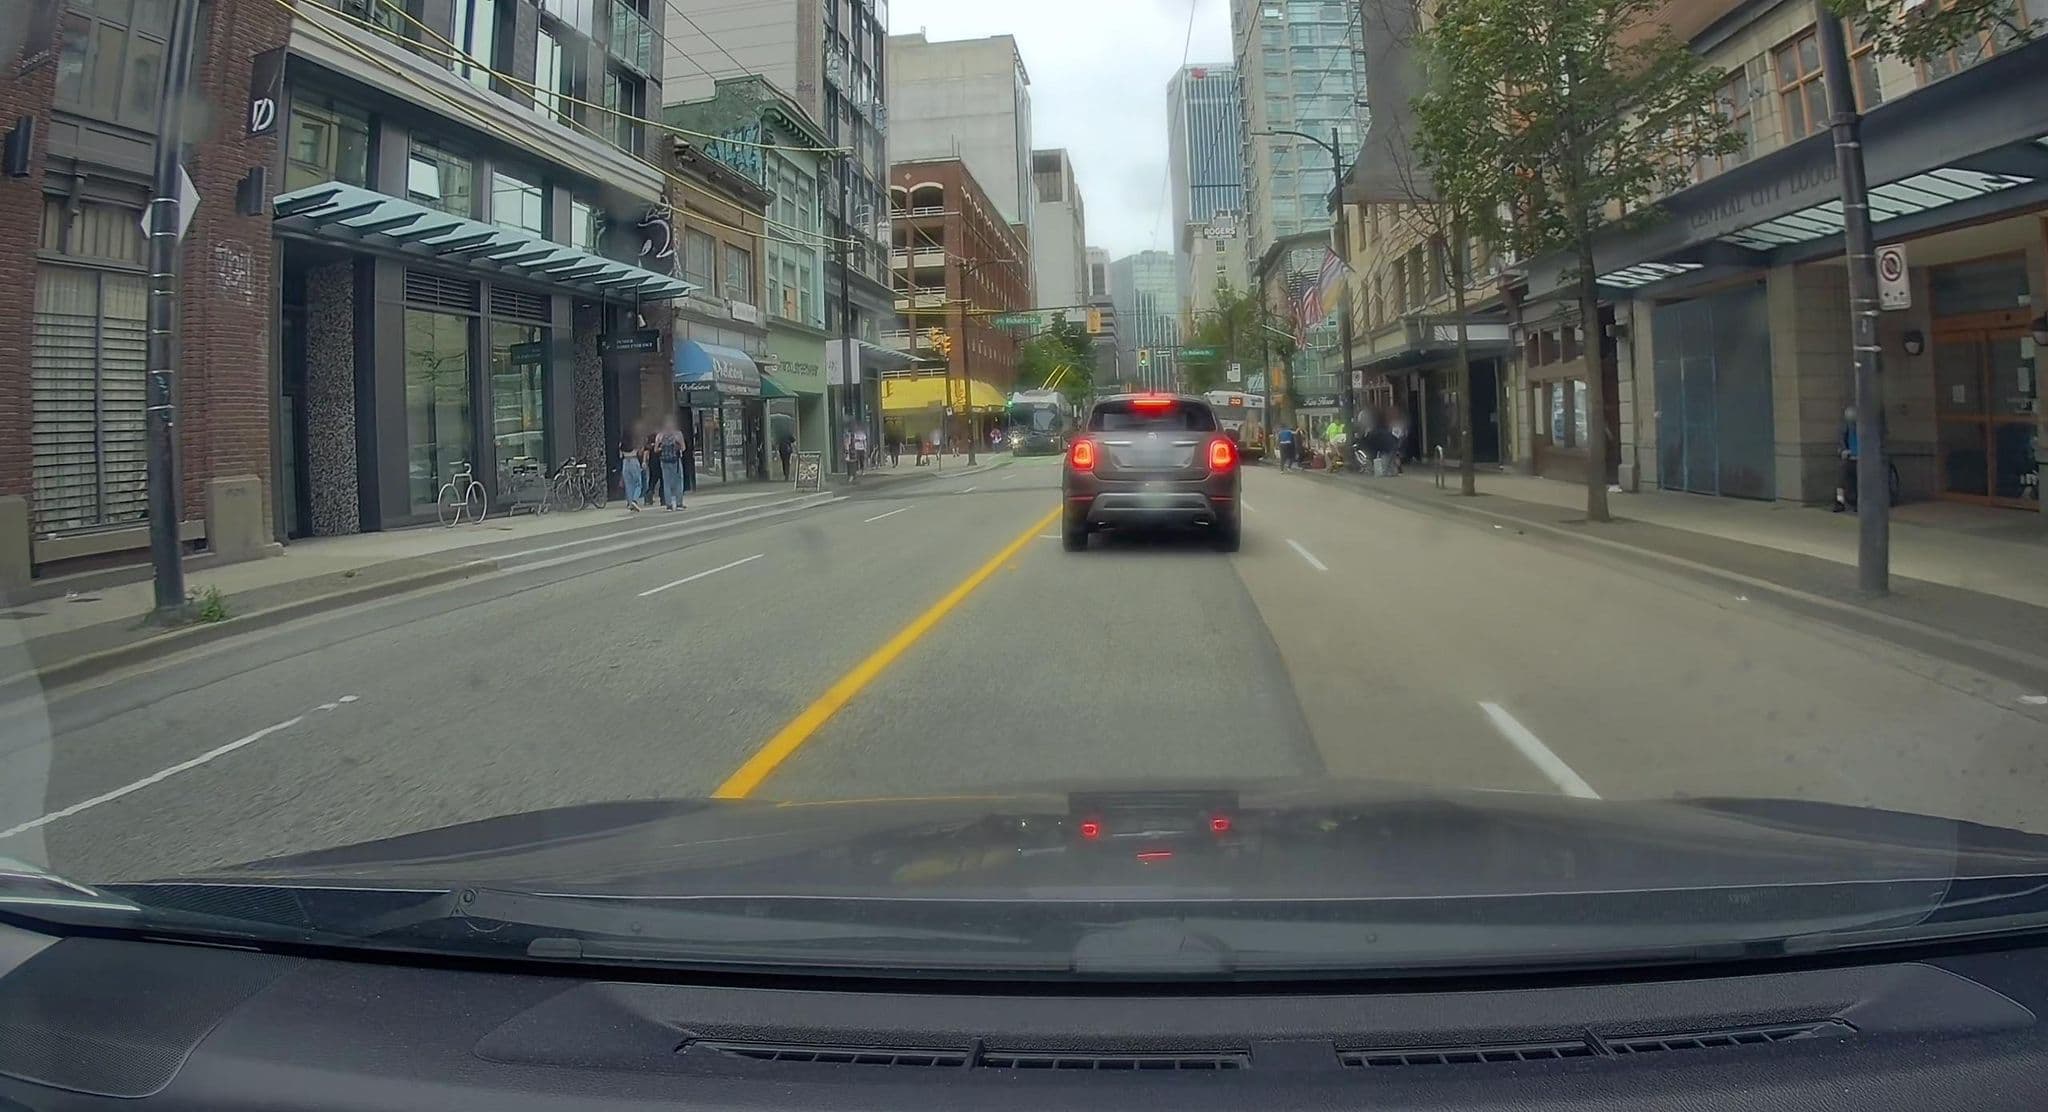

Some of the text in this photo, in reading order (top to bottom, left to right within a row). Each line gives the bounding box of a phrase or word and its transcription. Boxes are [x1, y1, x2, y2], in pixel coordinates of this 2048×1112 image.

[1690, 194, 1744, 230] CENTRAL
[1751, 182, 1781, 207] CITY
[1204, 227, 1236, 235] ROGERS
